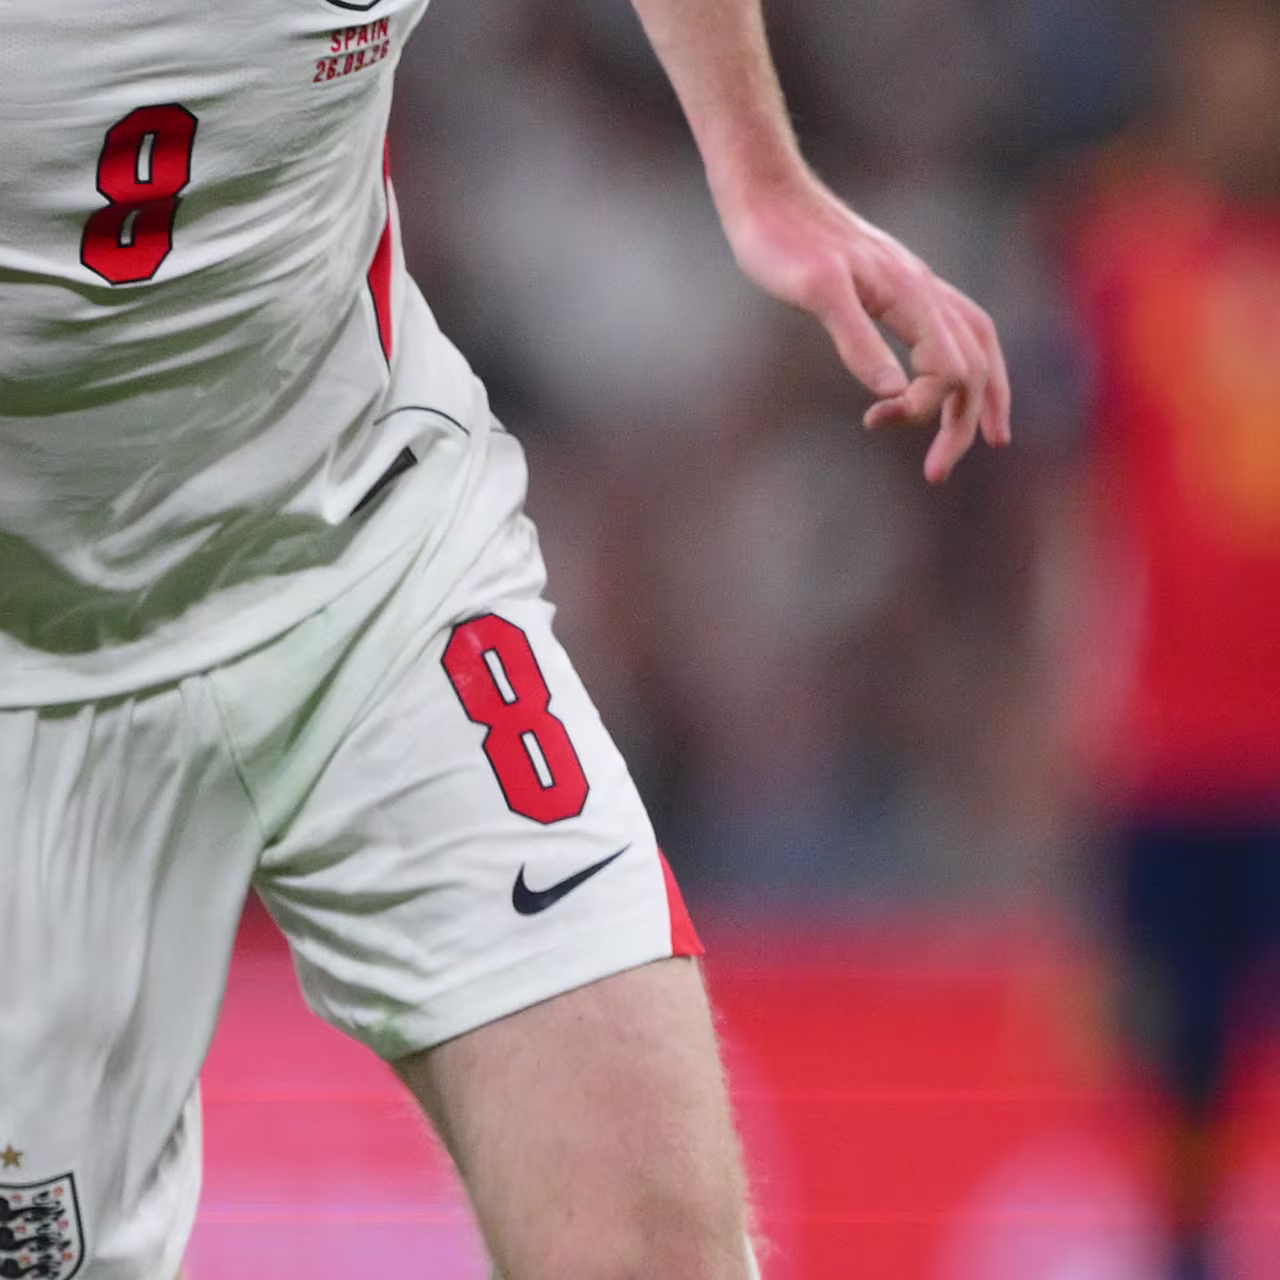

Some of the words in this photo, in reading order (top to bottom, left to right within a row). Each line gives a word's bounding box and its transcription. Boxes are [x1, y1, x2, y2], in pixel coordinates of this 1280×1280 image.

[312, 39, 390, 83] 26.09.26
[330, 17, 390, 53] SPAIN
[80, 102, 199, 286] 8
[440, 612, 590, 825] 8
